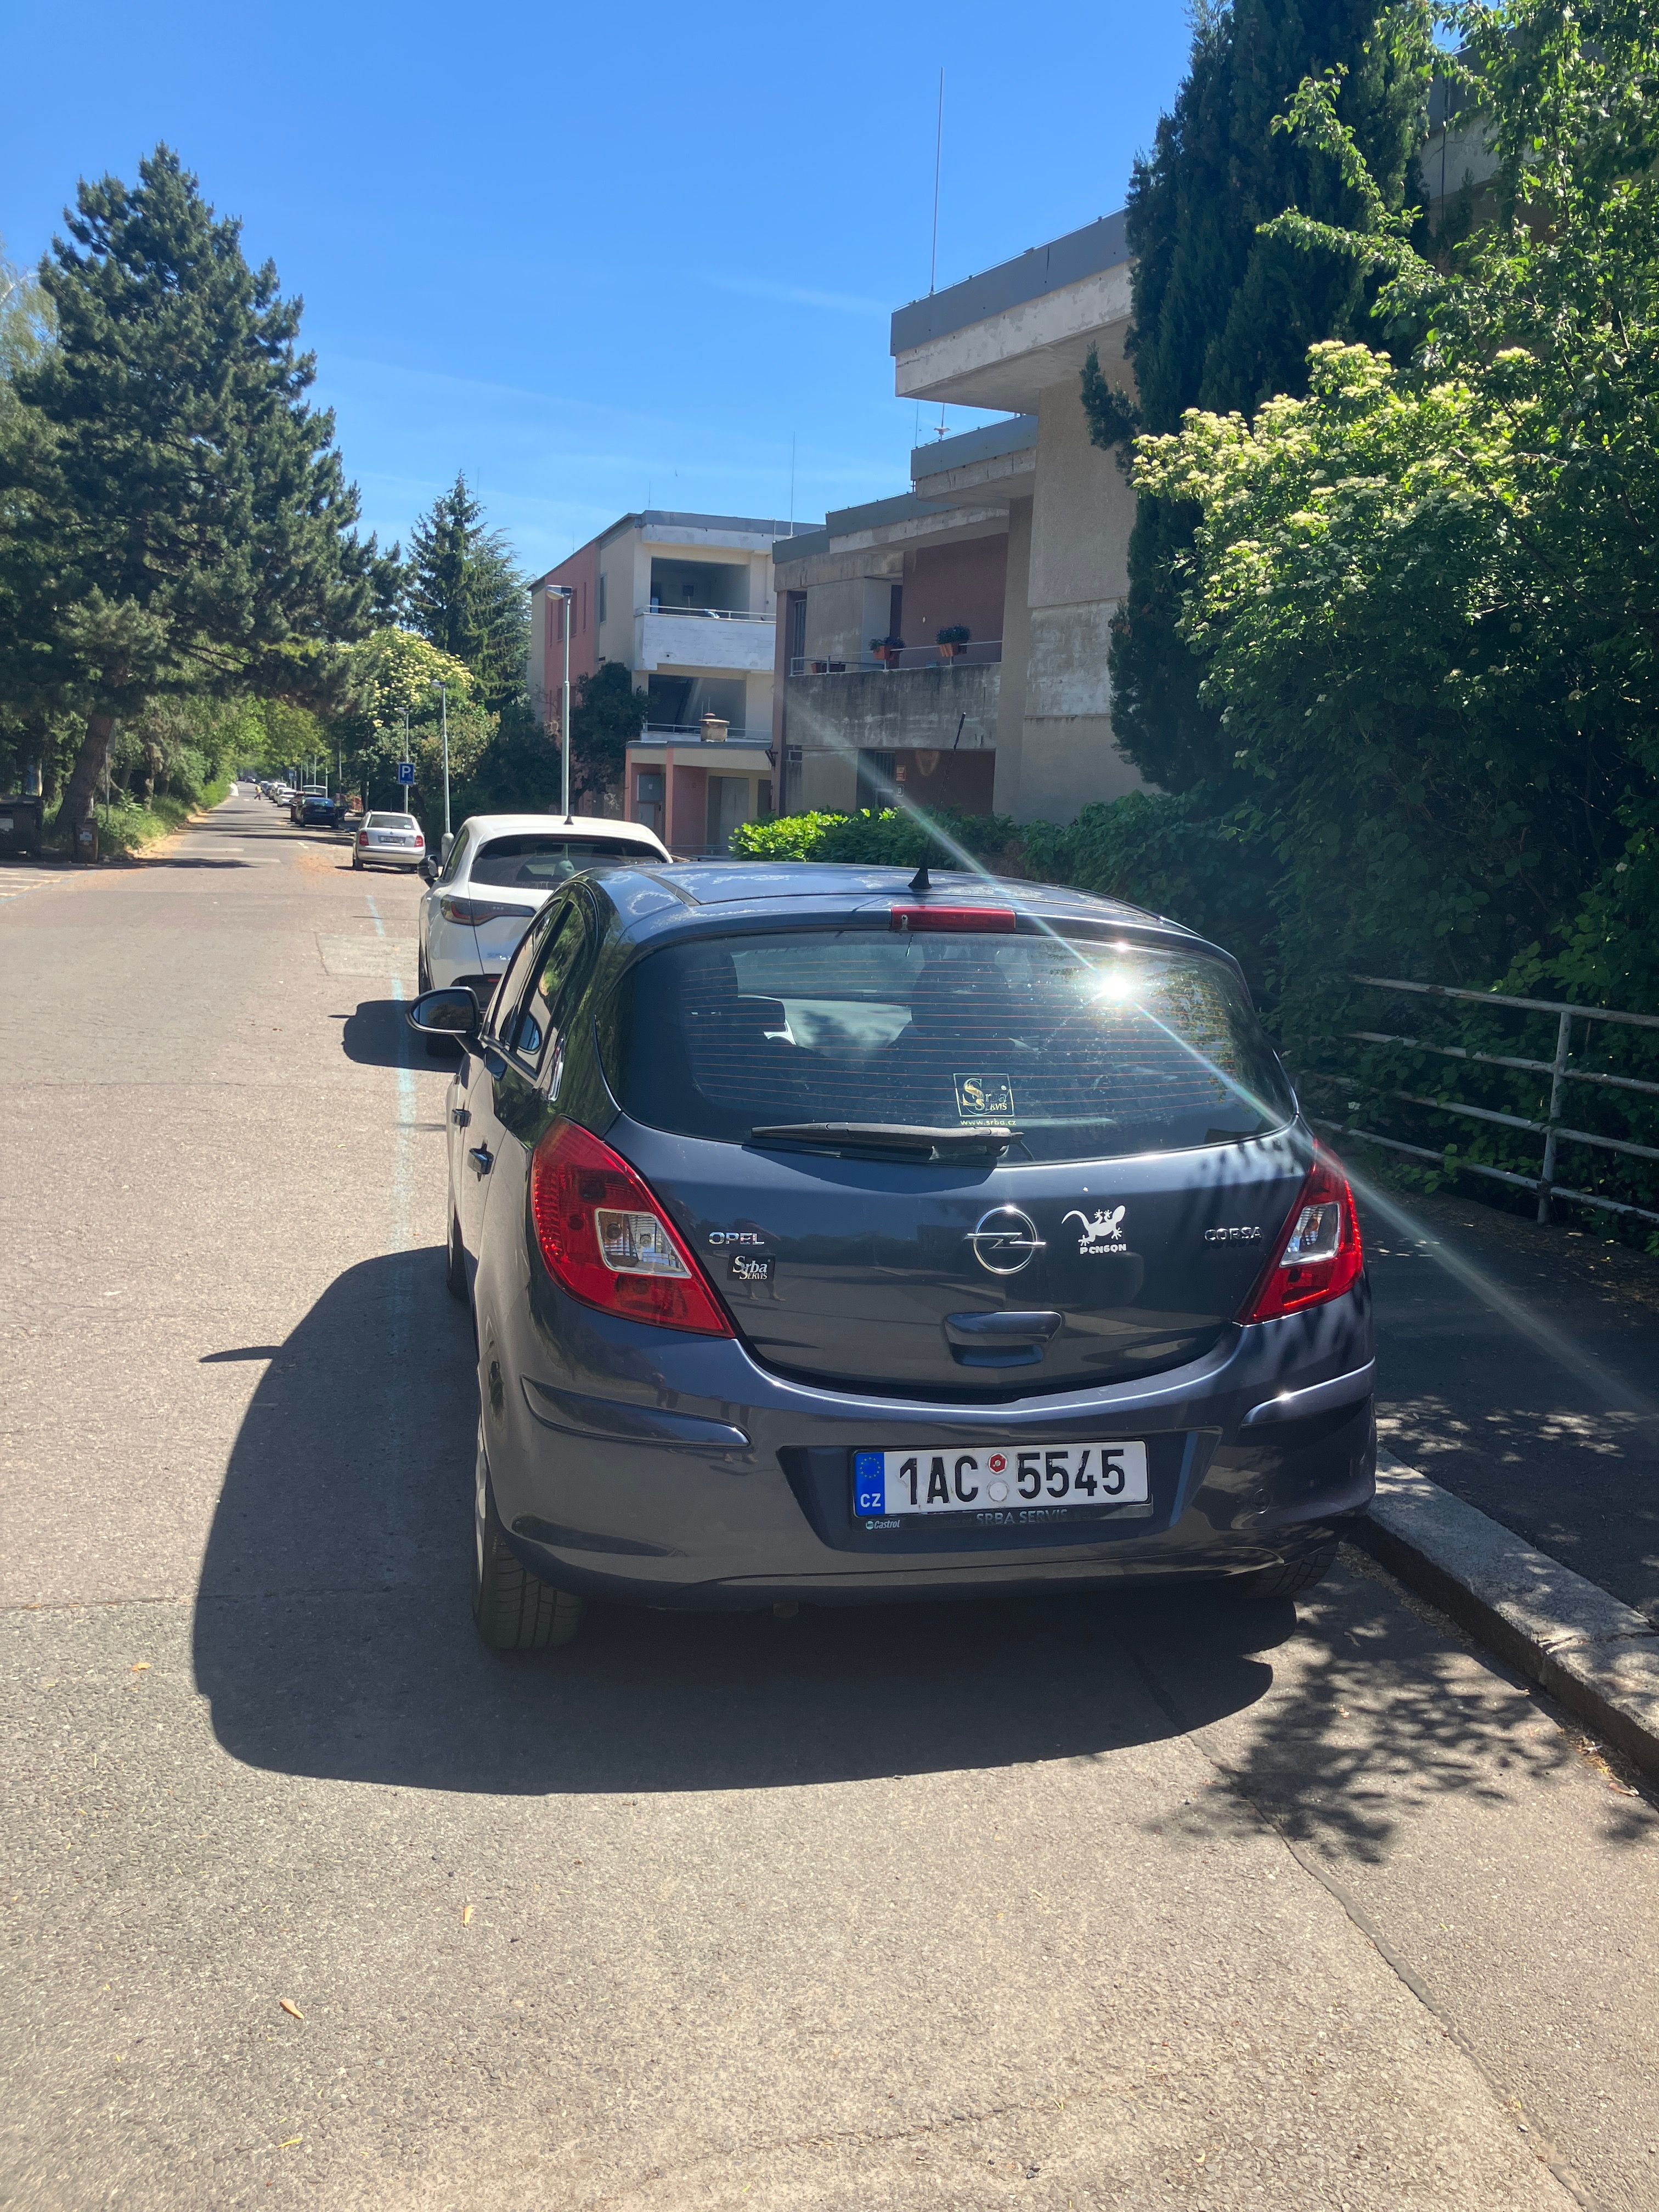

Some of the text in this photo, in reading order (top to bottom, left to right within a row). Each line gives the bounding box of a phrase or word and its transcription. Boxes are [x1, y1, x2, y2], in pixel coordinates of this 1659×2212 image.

[402, 765, 411, 777] P
[960, 1118, 1017, 1126] www.srba.cz
[709, 1232, 765, 1245] OPEL
[1204, 1226, 1262, 1242] CORSA
[732, 1255, 768, 1273] Srba
[739, 1267, 768, 1280] SERVIS
[900, 1449, 1125, 1505] 1AC 5545
[860, 1493, 881, 1508] CZ
[873, 1520, 900, 1530] Castrol
